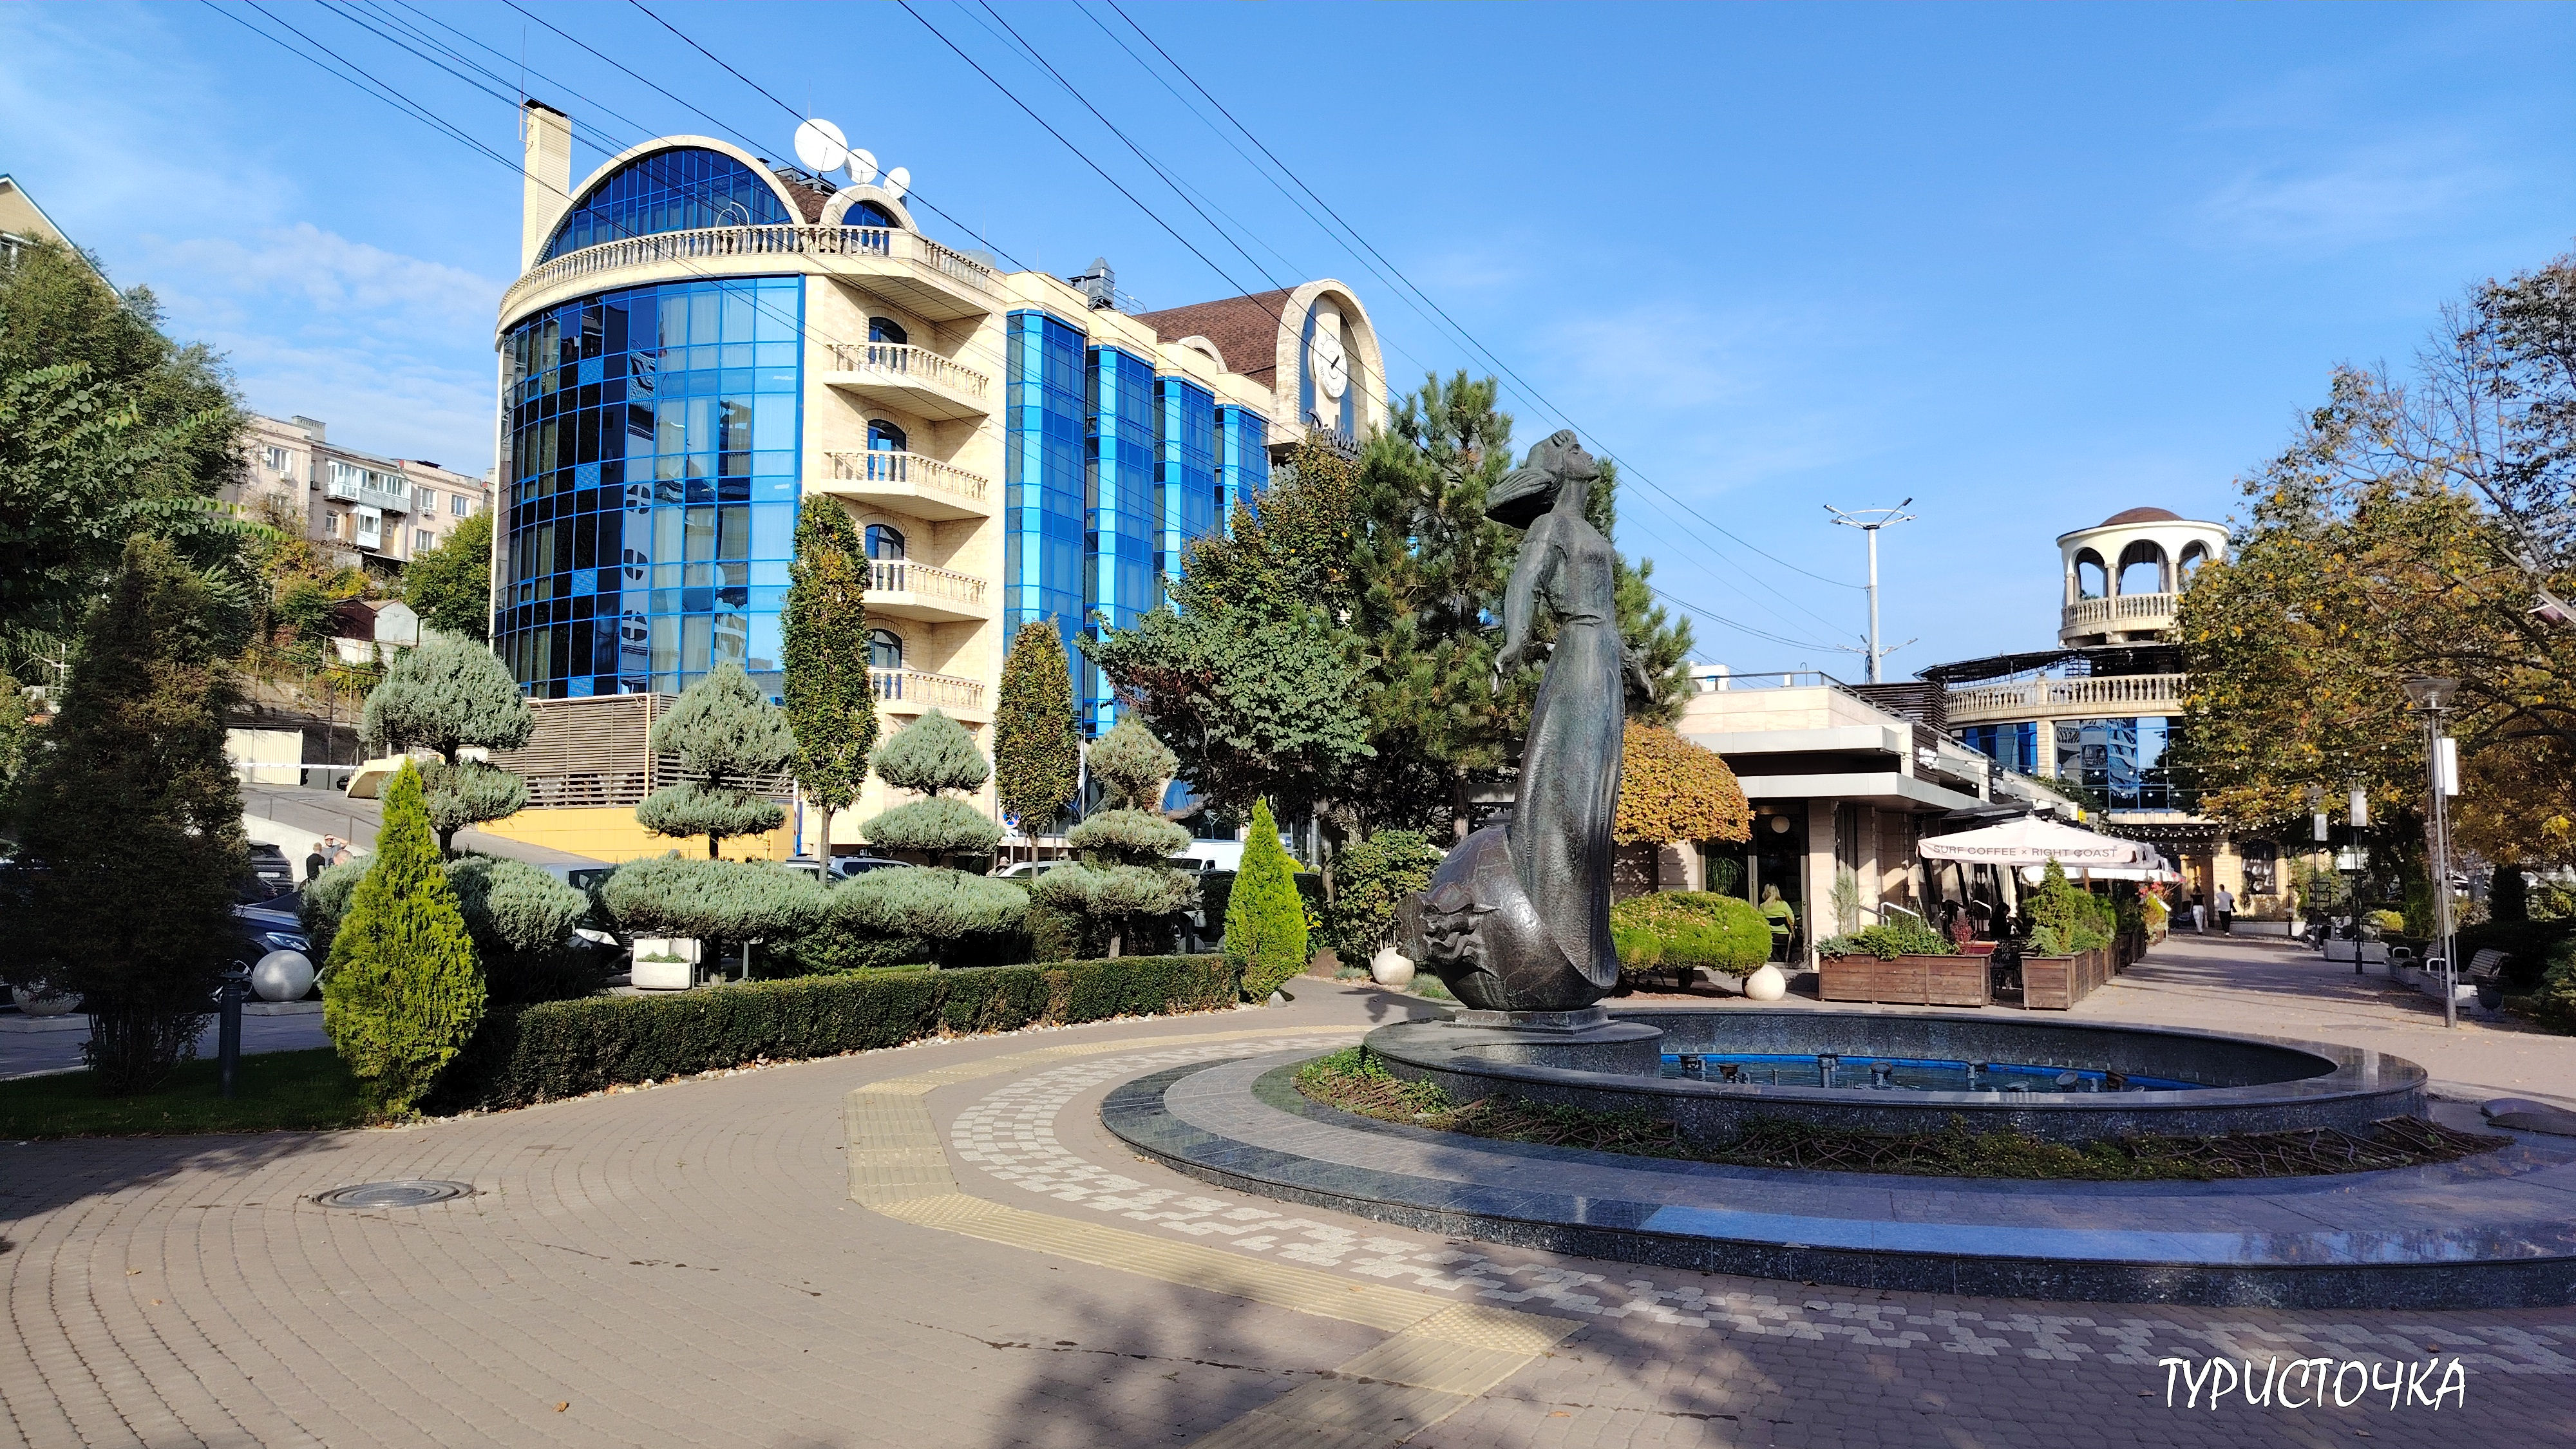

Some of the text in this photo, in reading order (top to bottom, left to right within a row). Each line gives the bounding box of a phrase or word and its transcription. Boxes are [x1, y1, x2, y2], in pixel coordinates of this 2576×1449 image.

[1933, 845, 1964, 854] SURF
[1967, 847, 2016, 856] COFFEE
[2032, 848, 2070, 857] RIGHT
[2074, 848, 2118, 857] COAST
